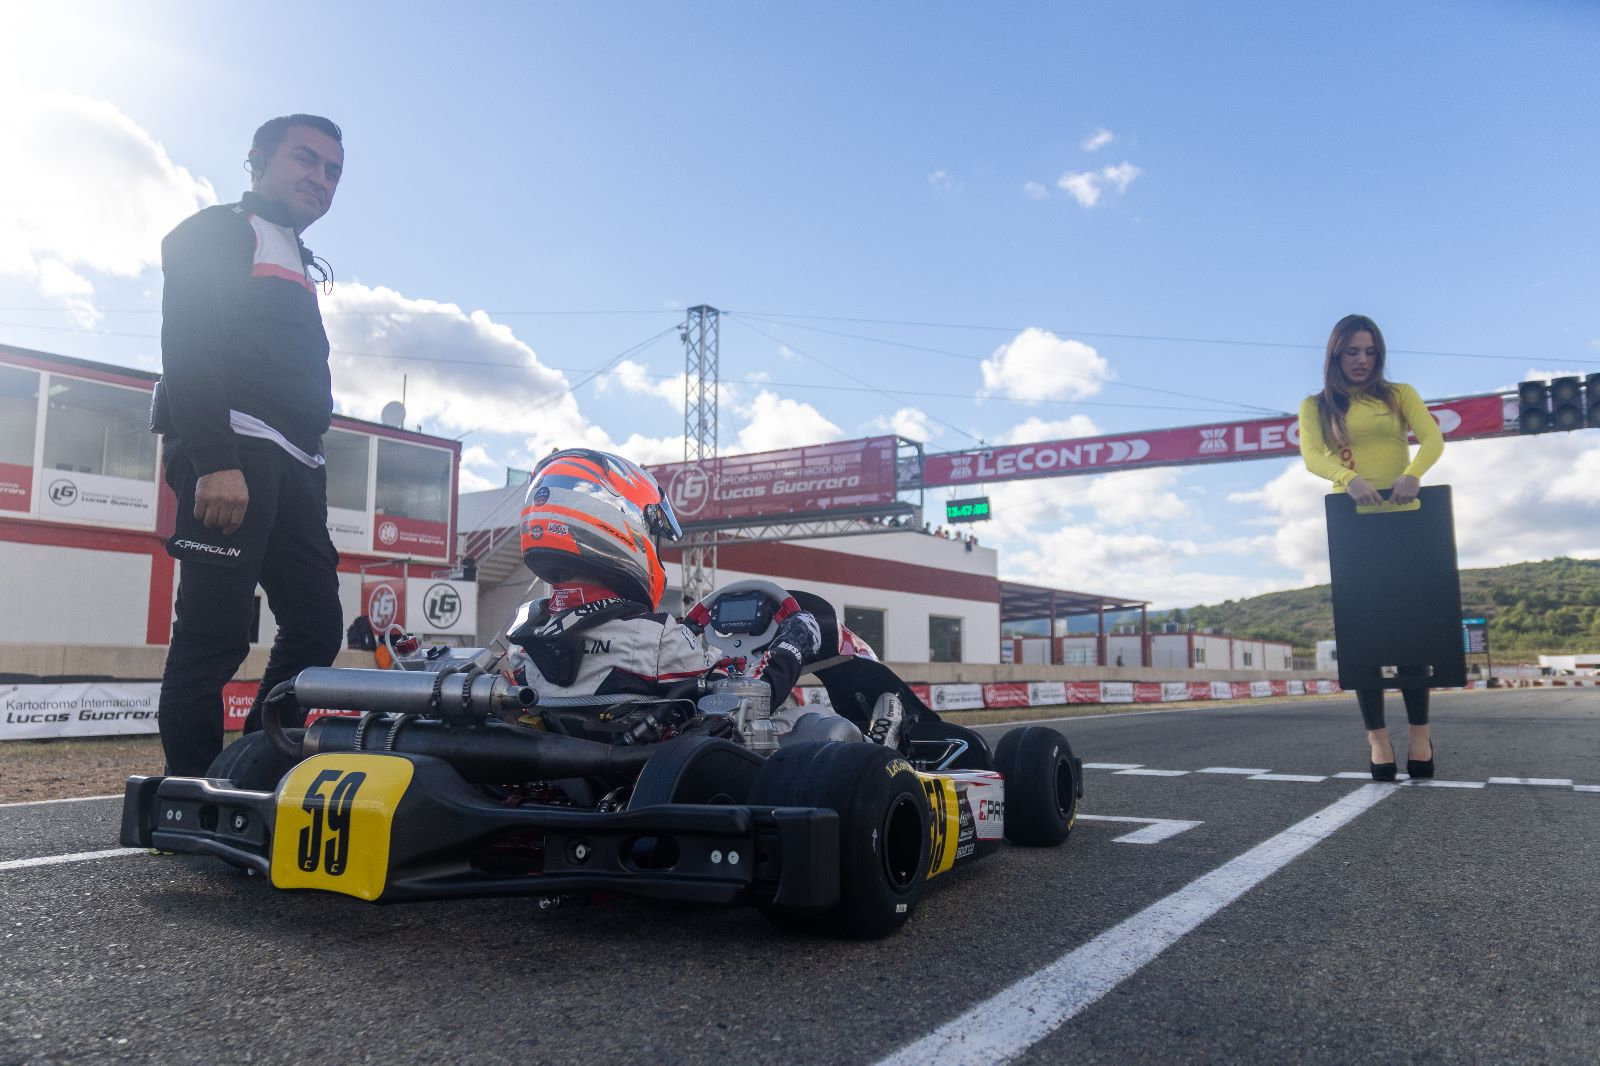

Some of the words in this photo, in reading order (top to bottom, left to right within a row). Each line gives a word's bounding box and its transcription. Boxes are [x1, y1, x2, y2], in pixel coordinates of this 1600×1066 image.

[713, 484, 766, 501] Lucas
[772, 475, 861, 495] Guerrero
[6, 699, 78, 711] Kartodromo
[81, 697, 151, 709] Internacional
[228, 695, 255, 705] Karto
[6, 712, 71, 724] Lucas
[297, 769, 367, 877] 59
